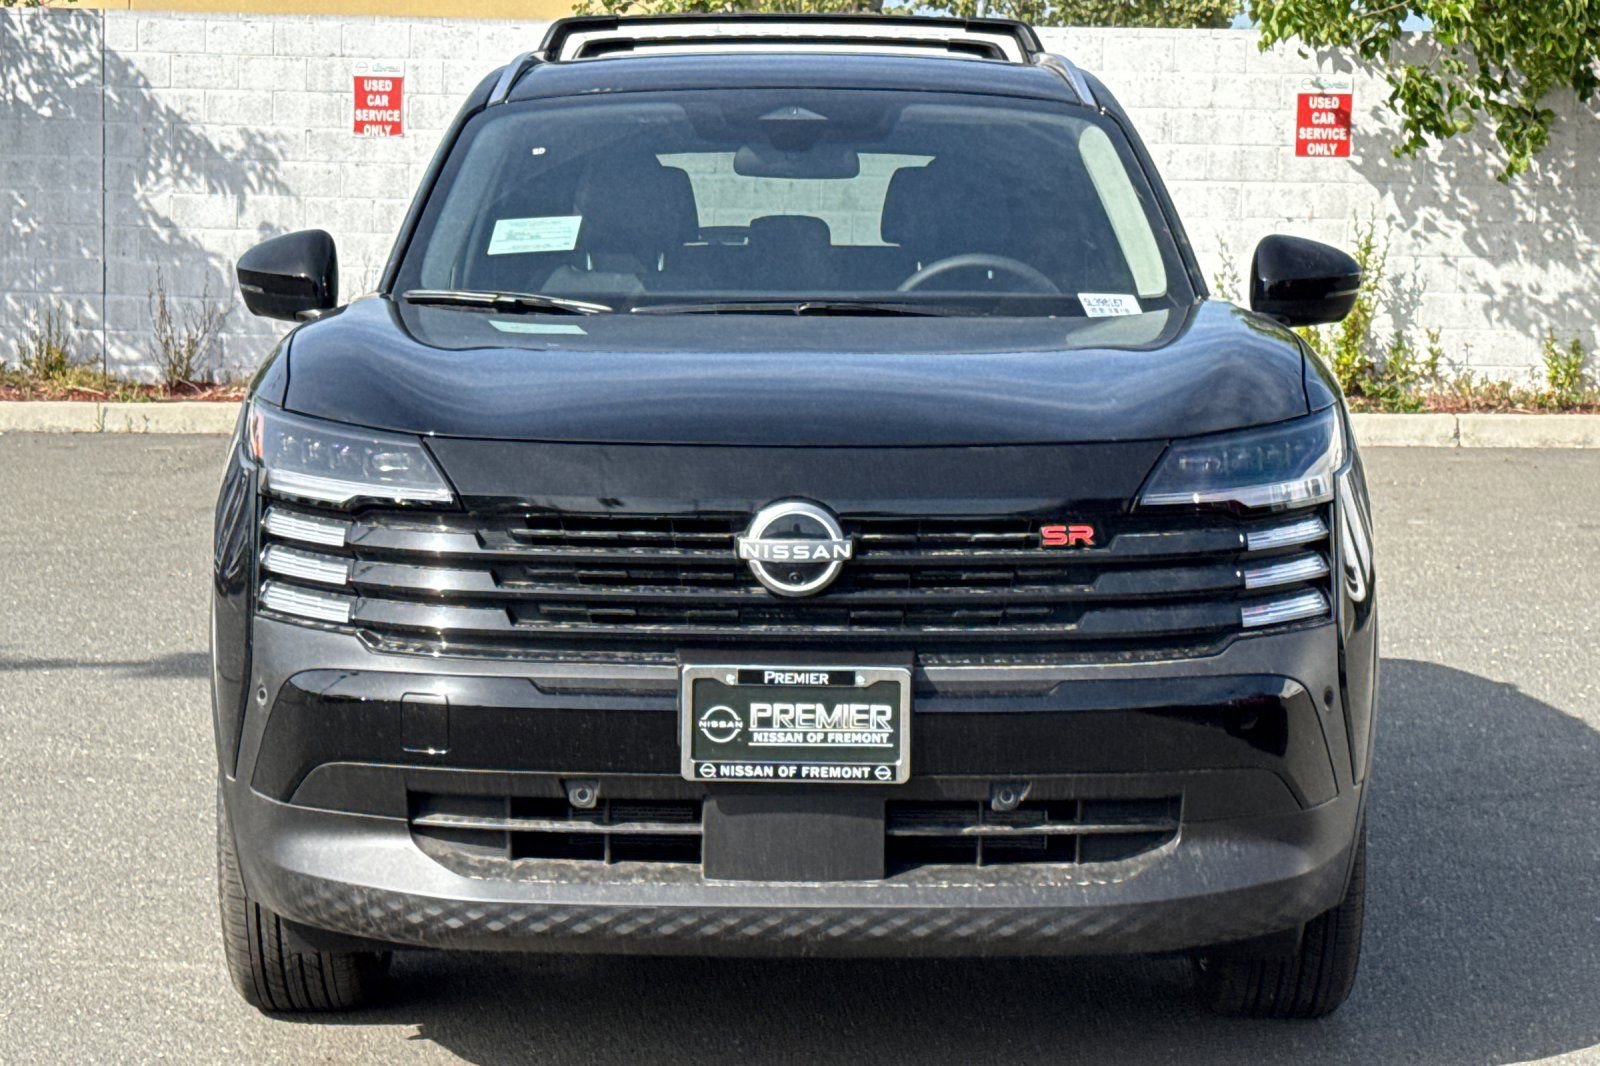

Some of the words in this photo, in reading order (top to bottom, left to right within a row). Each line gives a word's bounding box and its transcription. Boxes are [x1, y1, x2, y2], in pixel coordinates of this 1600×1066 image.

[363, 80, 393, 92] USED
[366, 95, 389, 107] CAR
[1308, 96, 1340, 109] USED
[355, 109, 400, 122] SERVICE
[1311, 112, 1336, 125] CAR
[363, 124, 392, 137] ONLY
[1298, 128, 1347, 140] SERVICE
[1306, 143, 1338, 155] ONLY
[1041, 524, 1096, 546] SR
[742, 543, 851, 560] NISSAN
[764, 671, 829, 685] PREMIER
[749, 703, 893, 729] PREMIER
[698, 720, 744, 729] NISSAN
[753, 732, 802, 743] NISSAN
[806, 733, 824, 743] OF
[827, 733, 890, 743] FREMONT
[719, 765, 773, 777] NISSAN
[778, 765, 798, 777] OF
[801, 766, 871, 778] FREMONT
